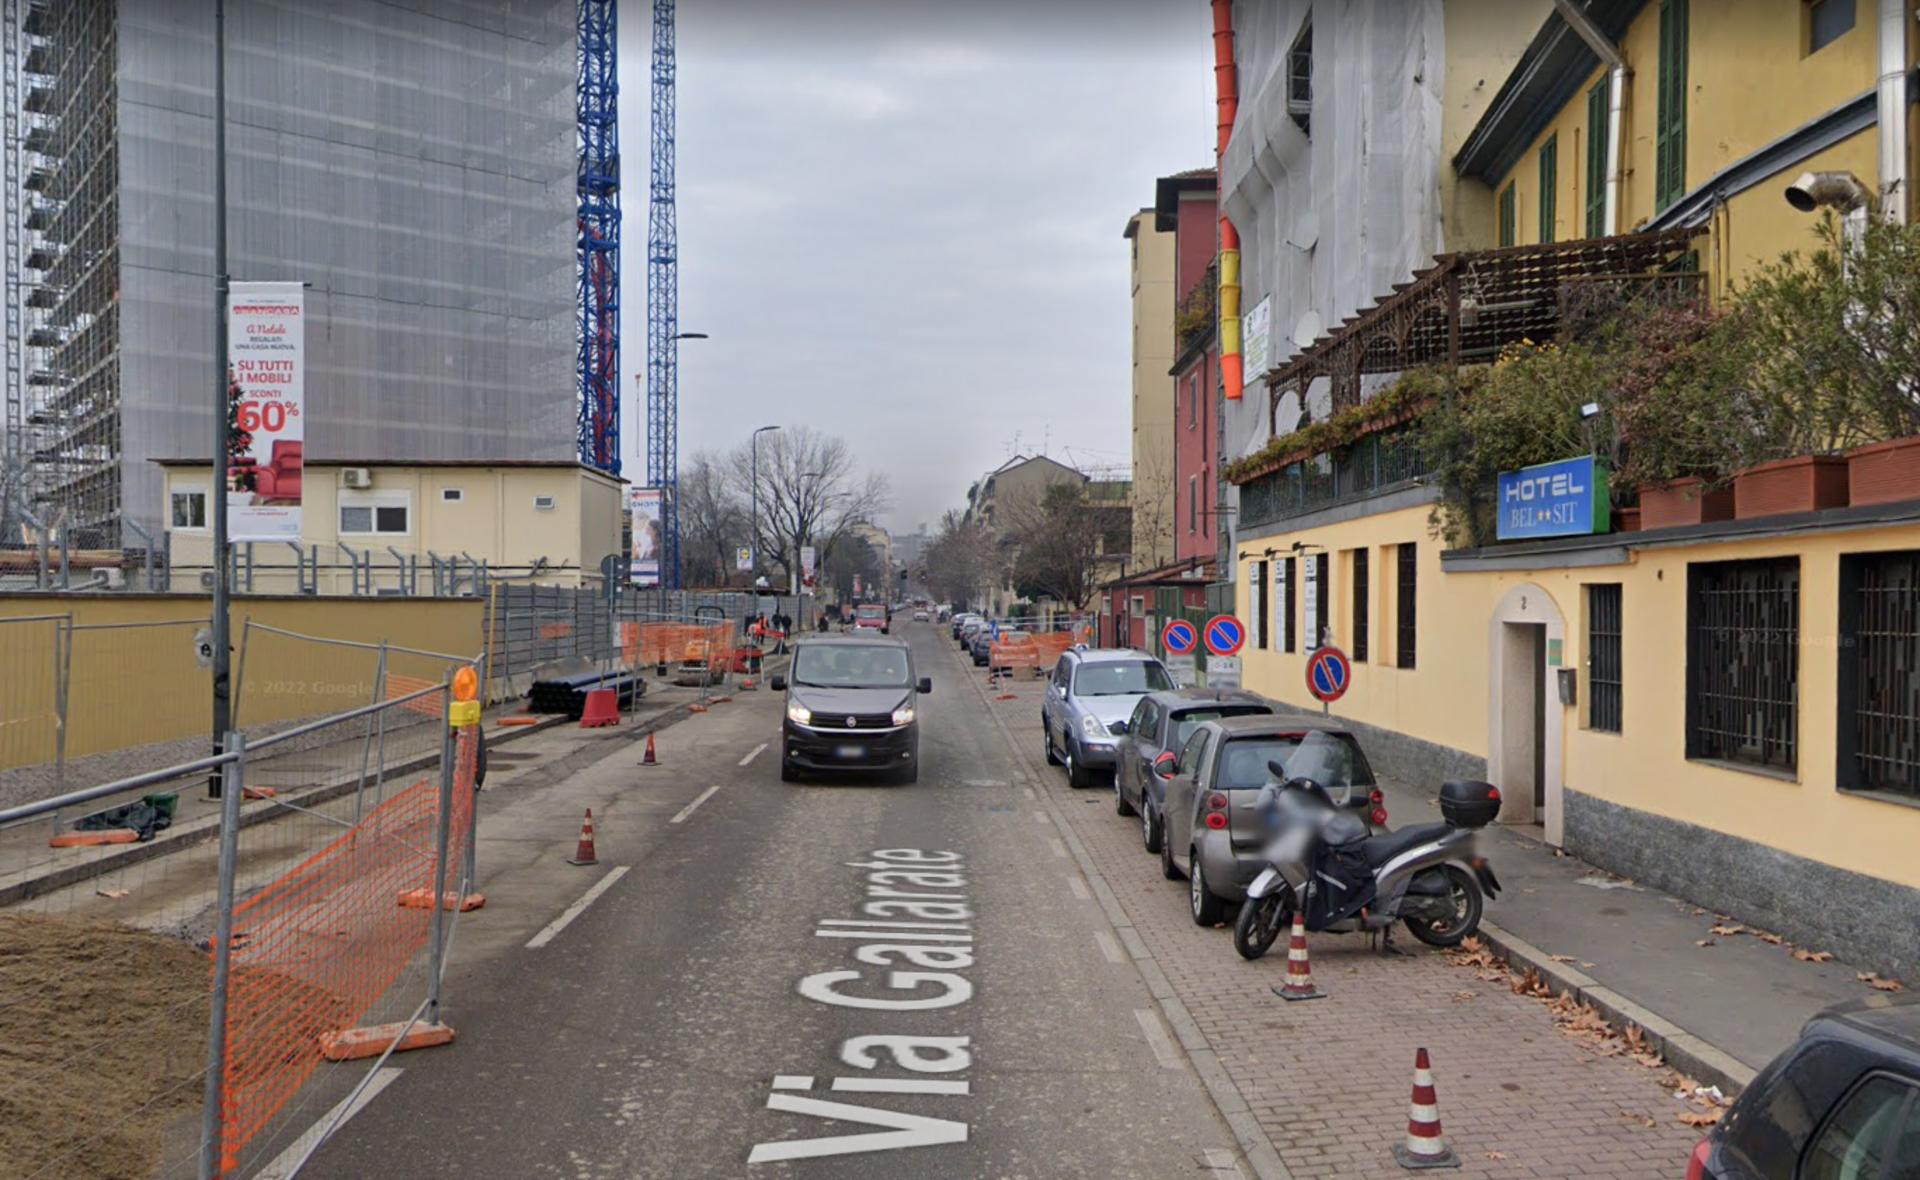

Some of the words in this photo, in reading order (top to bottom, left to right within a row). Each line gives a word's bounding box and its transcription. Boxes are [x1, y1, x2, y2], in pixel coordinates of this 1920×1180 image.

[238, 360, 255, 371] SU
[257, 360, 293, 371] TUTTI
[247, 372, 292, 384] MOBILI
[249, 389, 282, 398] SCONTI
[1506, 472, 1584, 502] HOTEL
[1510, 507, 1537, 529] BEL
[1553, 502, 1578, 523] SIT
